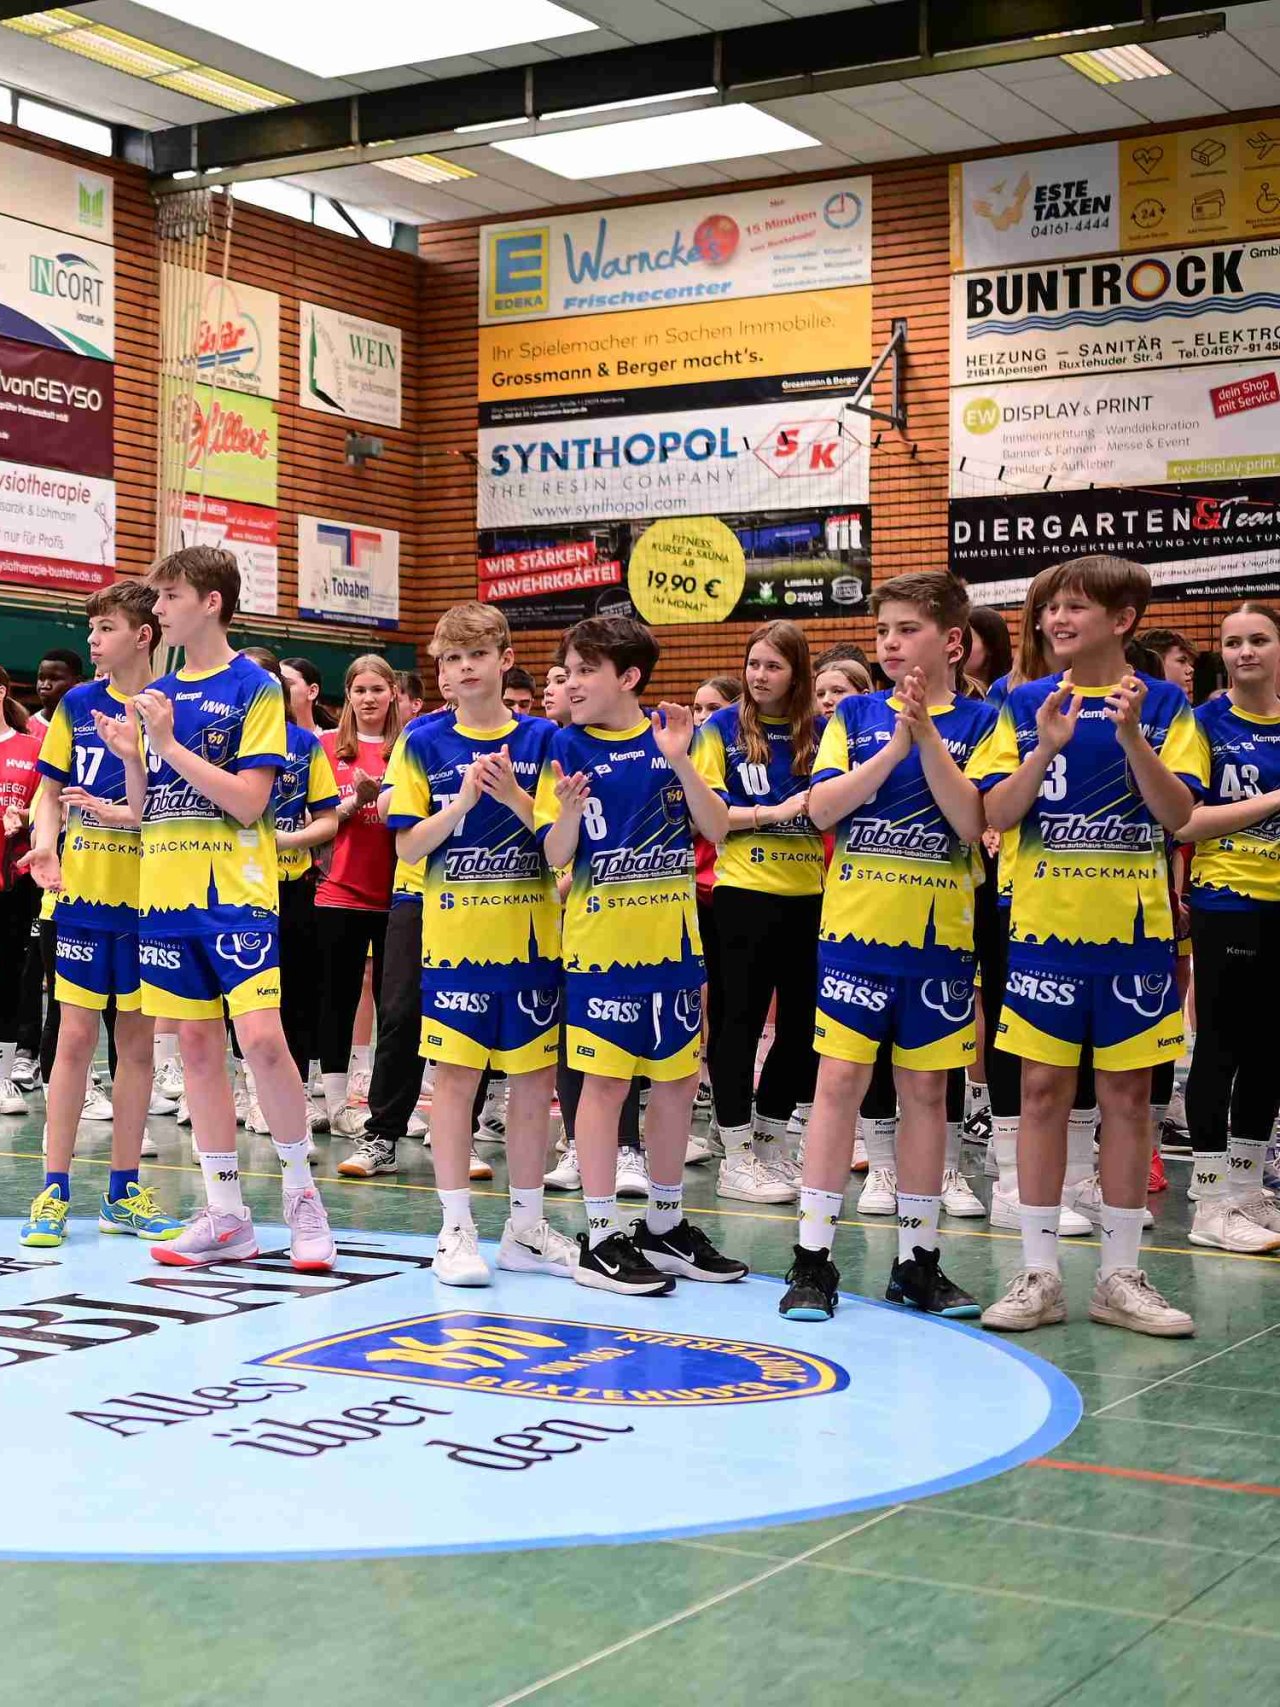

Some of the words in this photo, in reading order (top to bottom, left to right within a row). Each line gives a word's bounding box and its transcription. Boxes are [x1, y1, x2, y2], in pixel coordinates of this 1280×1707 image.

[1035, 180, 1089, 204] ESTE
[1033, 194, 1111, 222] TAXEN
[746, 226, 761, 236] 15
[765, 211, 817, 230] Minuten
[1031, 217, 1110, 239] 04161-4444
[494, 294, 544, 311] EDEKA
[563, 281, 733, 310] Frischecenter
[349, 333, 397, 370] WEIN
[491, 344, 514, 362] Ihr
[519, 333, 638, 368] Spielemacher
[644, 330, 659, 346] in
[664, 323, 733, 345] Sachen
[738, 313, 836, 336] Immobilie.
[966, 348, 1048, 369] HEIZUNG
[1078, 336, 1162, 358] SANITÄR
[491, 364, 592, 388] Grossmann
[597, 363, 609, 377] &
[617, 357, 677, 380] Berger
[683, 346, 765, 371] macht's.
[997, 362, 1048, 375] Apensen
[1058, 355, 1127, 371] Buxtehuder
[1133, 352, 1154, 363] Str.
[1178, 348, 1199, 360] Tel.
[1201, 344, 1240, 357] 04167
[1218, 386, 1240, 401] dein
[1241, 379, 1270, 397] Shop
[1218, 400, 1236, 414] mit
[1237, 388, 1277, 410] Service
[965, 409, 997, 427] EW
[1002, 402, 1080, 423] DISPLAY
[1082, 405, 1091, 416] &
[1096, 395, 1154, 414] PRINT
[1002, 427, 1096, 445] Inneneinrichtung
[1104, 418, 1200, 437] Wanddekoration
[490, 426, 739, 477] SYNTHOPOL
[809, 442, 838, 470] K
[1002, 448, 1041, 461] Banner
[1054, 444, 1097, 457] Fahnen
[1106, 438, 1144, 452] Messe
[1145, 439, 1155, 450] &
[1156, 436, 1190, 449] Event
[1059, 457, 1116, 473] Aufkleber
[489, 482, 526, 499] THE
[542, 478, 606, 496] RESIN
[623, 468, 737, 490] COMPANY
[532, 494, 688, 518] www.synthopol.com
[4, 529, 21, 542] nur
[23, 530, 36, 546] für
[38, 532, 64, 550] Profis
[652, 542, 684, 554] KURSE
[696, 550, 730, 563] SAUNA
[672, 534, 712, 547] FITNESS
[486, 557, 515, 573] WIR
[519, 546, 588, 569] STÄRKEN
[331, 577, 369, 600] Tobaben
[487, 562, 617, 598] ABWEHRKRÄFTE!
[647, 570, 697, 594] 19,90
[704, 579, 722, 599] €
[175, 691, 202, 702] Kempa
[199, 699, 232, 717] MWM
[609, 750, 646, 763] Kempa
[736, 762, 771, 796] 10
[1220, 763, 1263, 801] 43
[582, 796, 608, 841] 8
[1039, 814, 1150, 844] Tobaben
[149, 839, 233, 854] STACKMANN
[446, 848, 540, 876] Tobaben
[856, 868, 958, 890] STACKMANN
[68, 1376, 308, 1438] Alles
[212, 1393, 453, 1458] über
[426, 1417, 635, 1472] den
